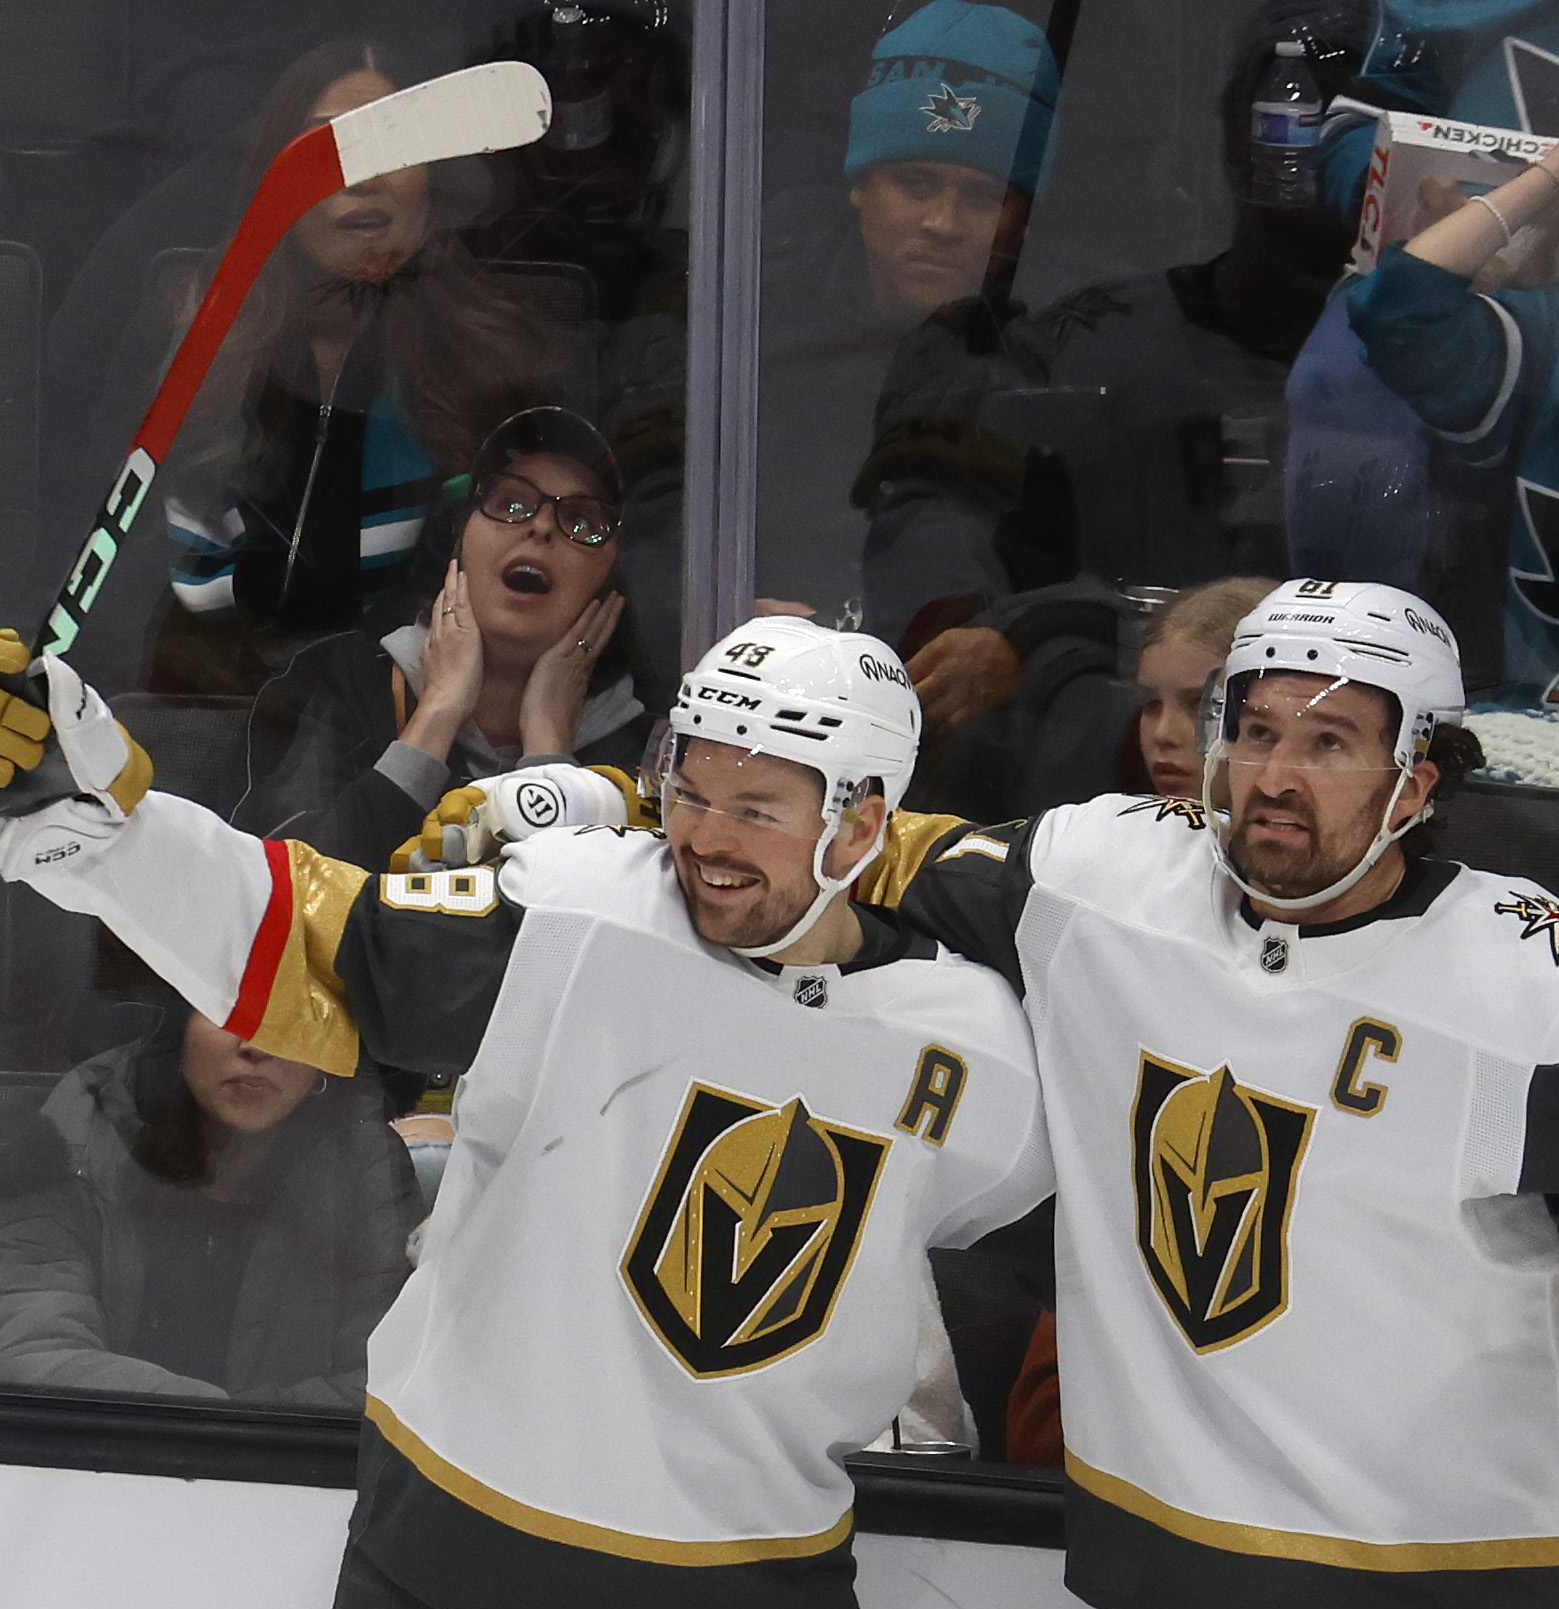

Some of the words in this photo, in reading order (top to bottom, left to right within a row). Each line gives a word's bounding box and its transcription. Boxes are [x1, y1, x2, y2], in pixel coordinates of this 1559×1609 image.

[1268, 613, 1336, 625] WARRIOR
[697, 686, 763, 711] CCM
[895, 1043, 969, 1147] A
[1329, 1016, 1403, 1117] C
